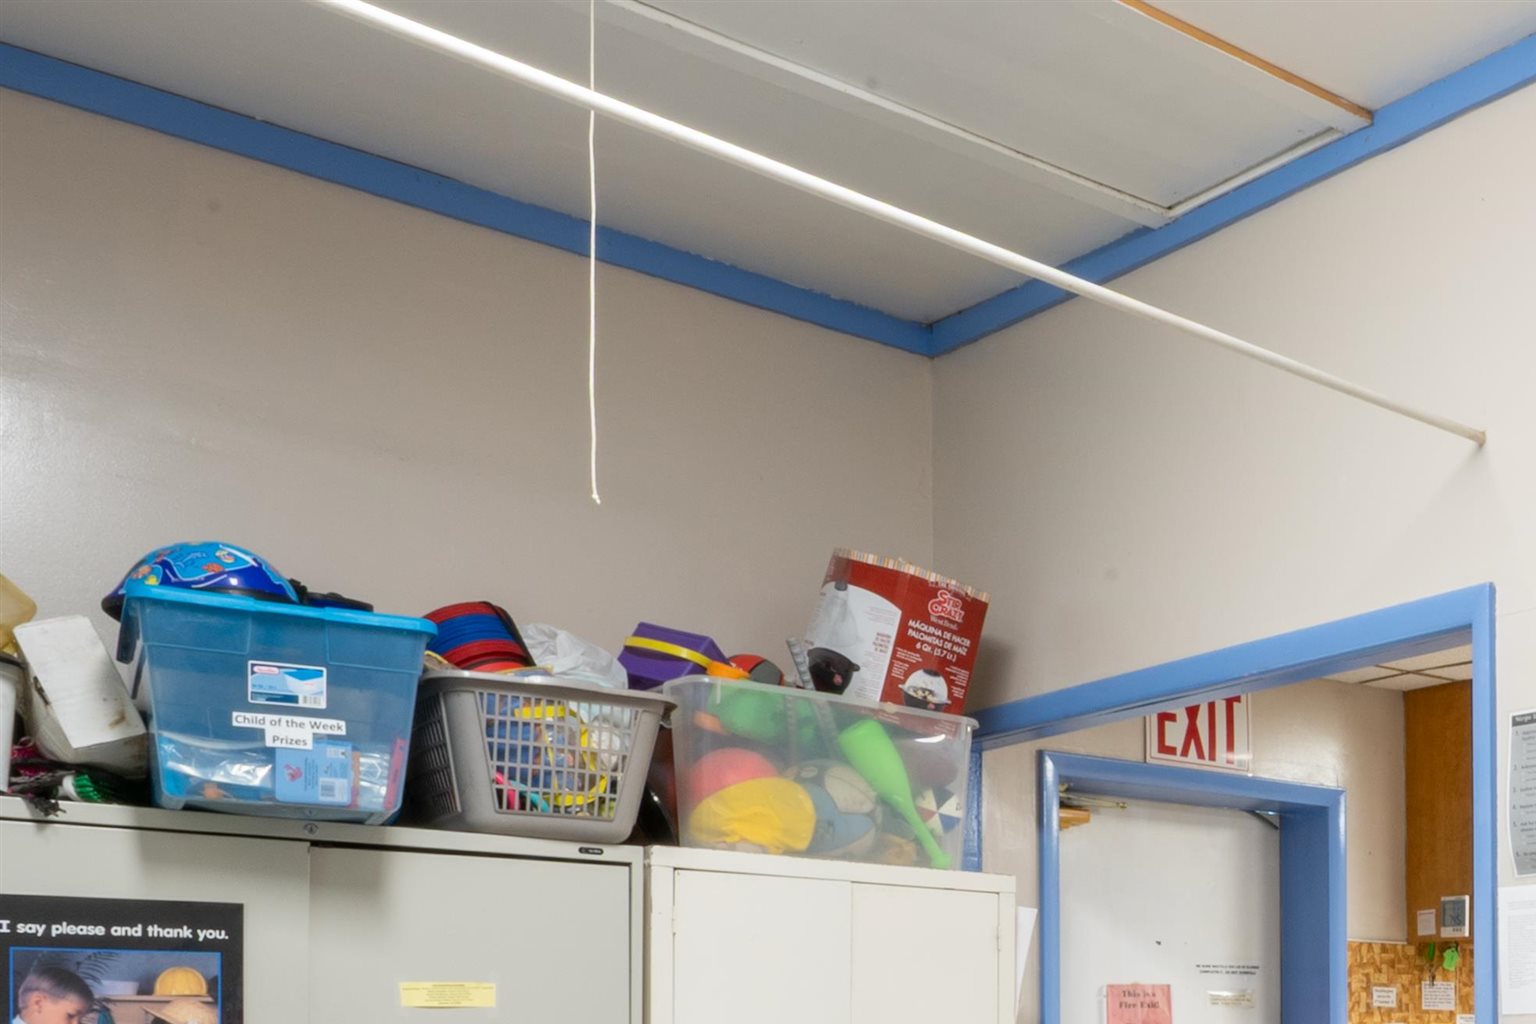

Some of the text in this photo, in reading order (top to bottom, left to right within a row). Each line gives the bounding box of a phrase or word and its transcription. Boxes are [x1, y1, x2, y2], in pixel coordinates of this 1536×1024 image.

[234, 714, 344, 732] Child of the Week
[1157, 695, 1242, 764] EXIT
[272, 735, 308, 747] Prizes
[0, 920, 229, 942] I say please and thank you.
[1121, 990, 1140, 998] This
[1119, 1001, 1137, 1009] Fire
